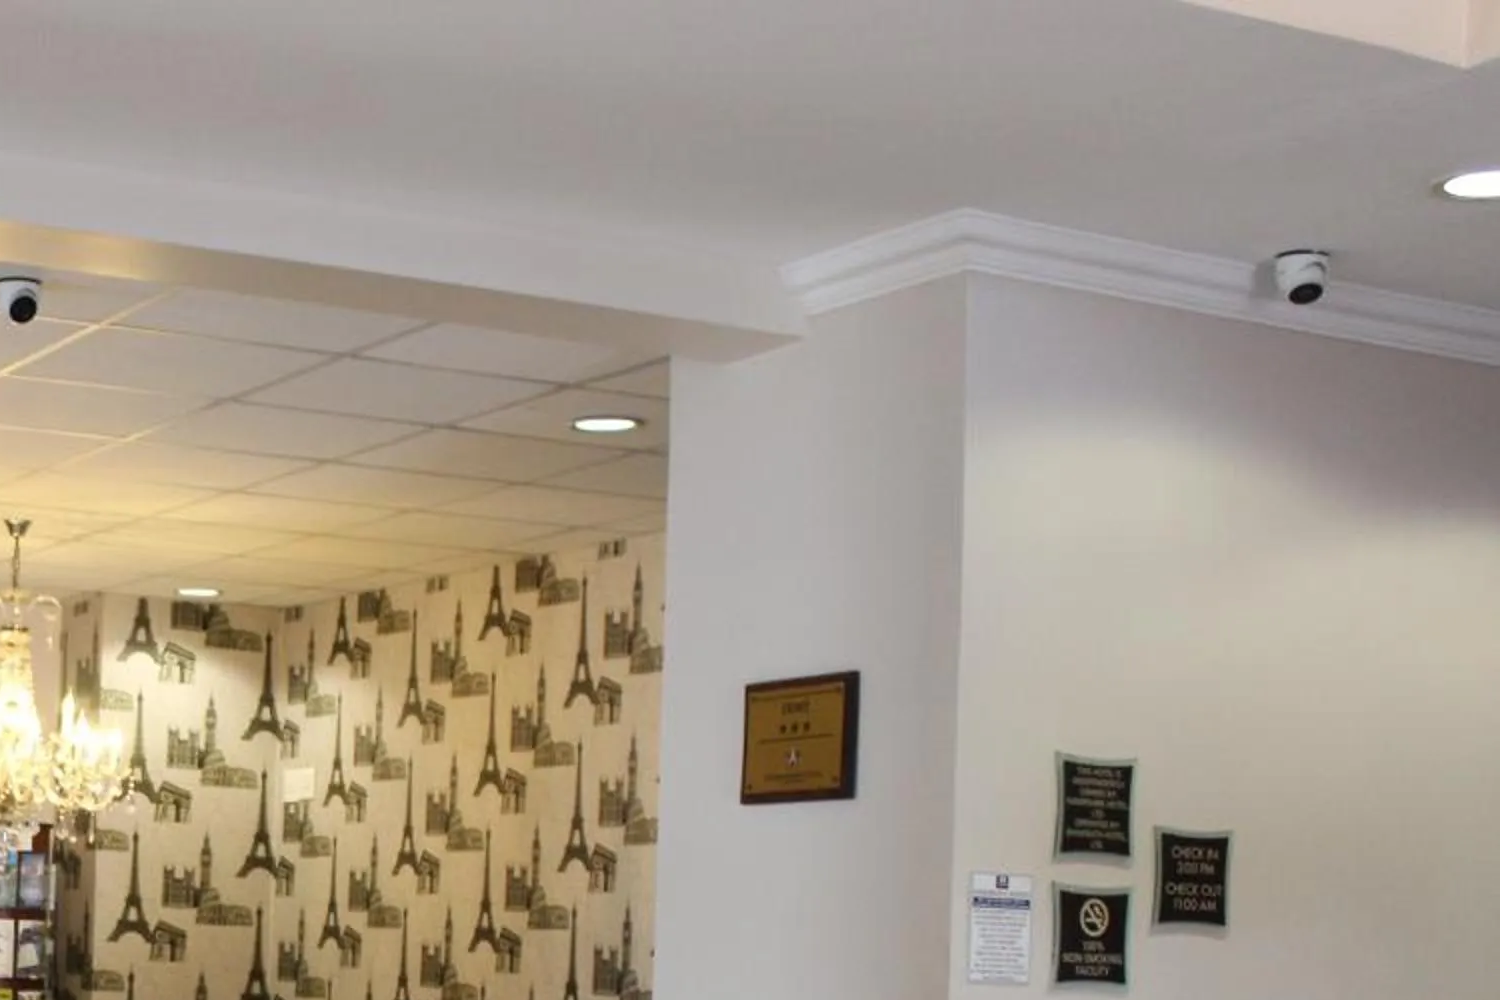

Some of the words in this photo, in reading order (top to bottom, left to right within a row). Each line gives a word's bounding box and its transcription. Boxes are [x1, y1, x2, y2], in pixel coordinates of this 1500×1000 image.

[1171, 845, 1203, 859] CHECK
[1164, 882, 1199, 896] CHECK
[1201, 884, 1222, 897] OUT
[1199, 900, 1217, 911] AM
